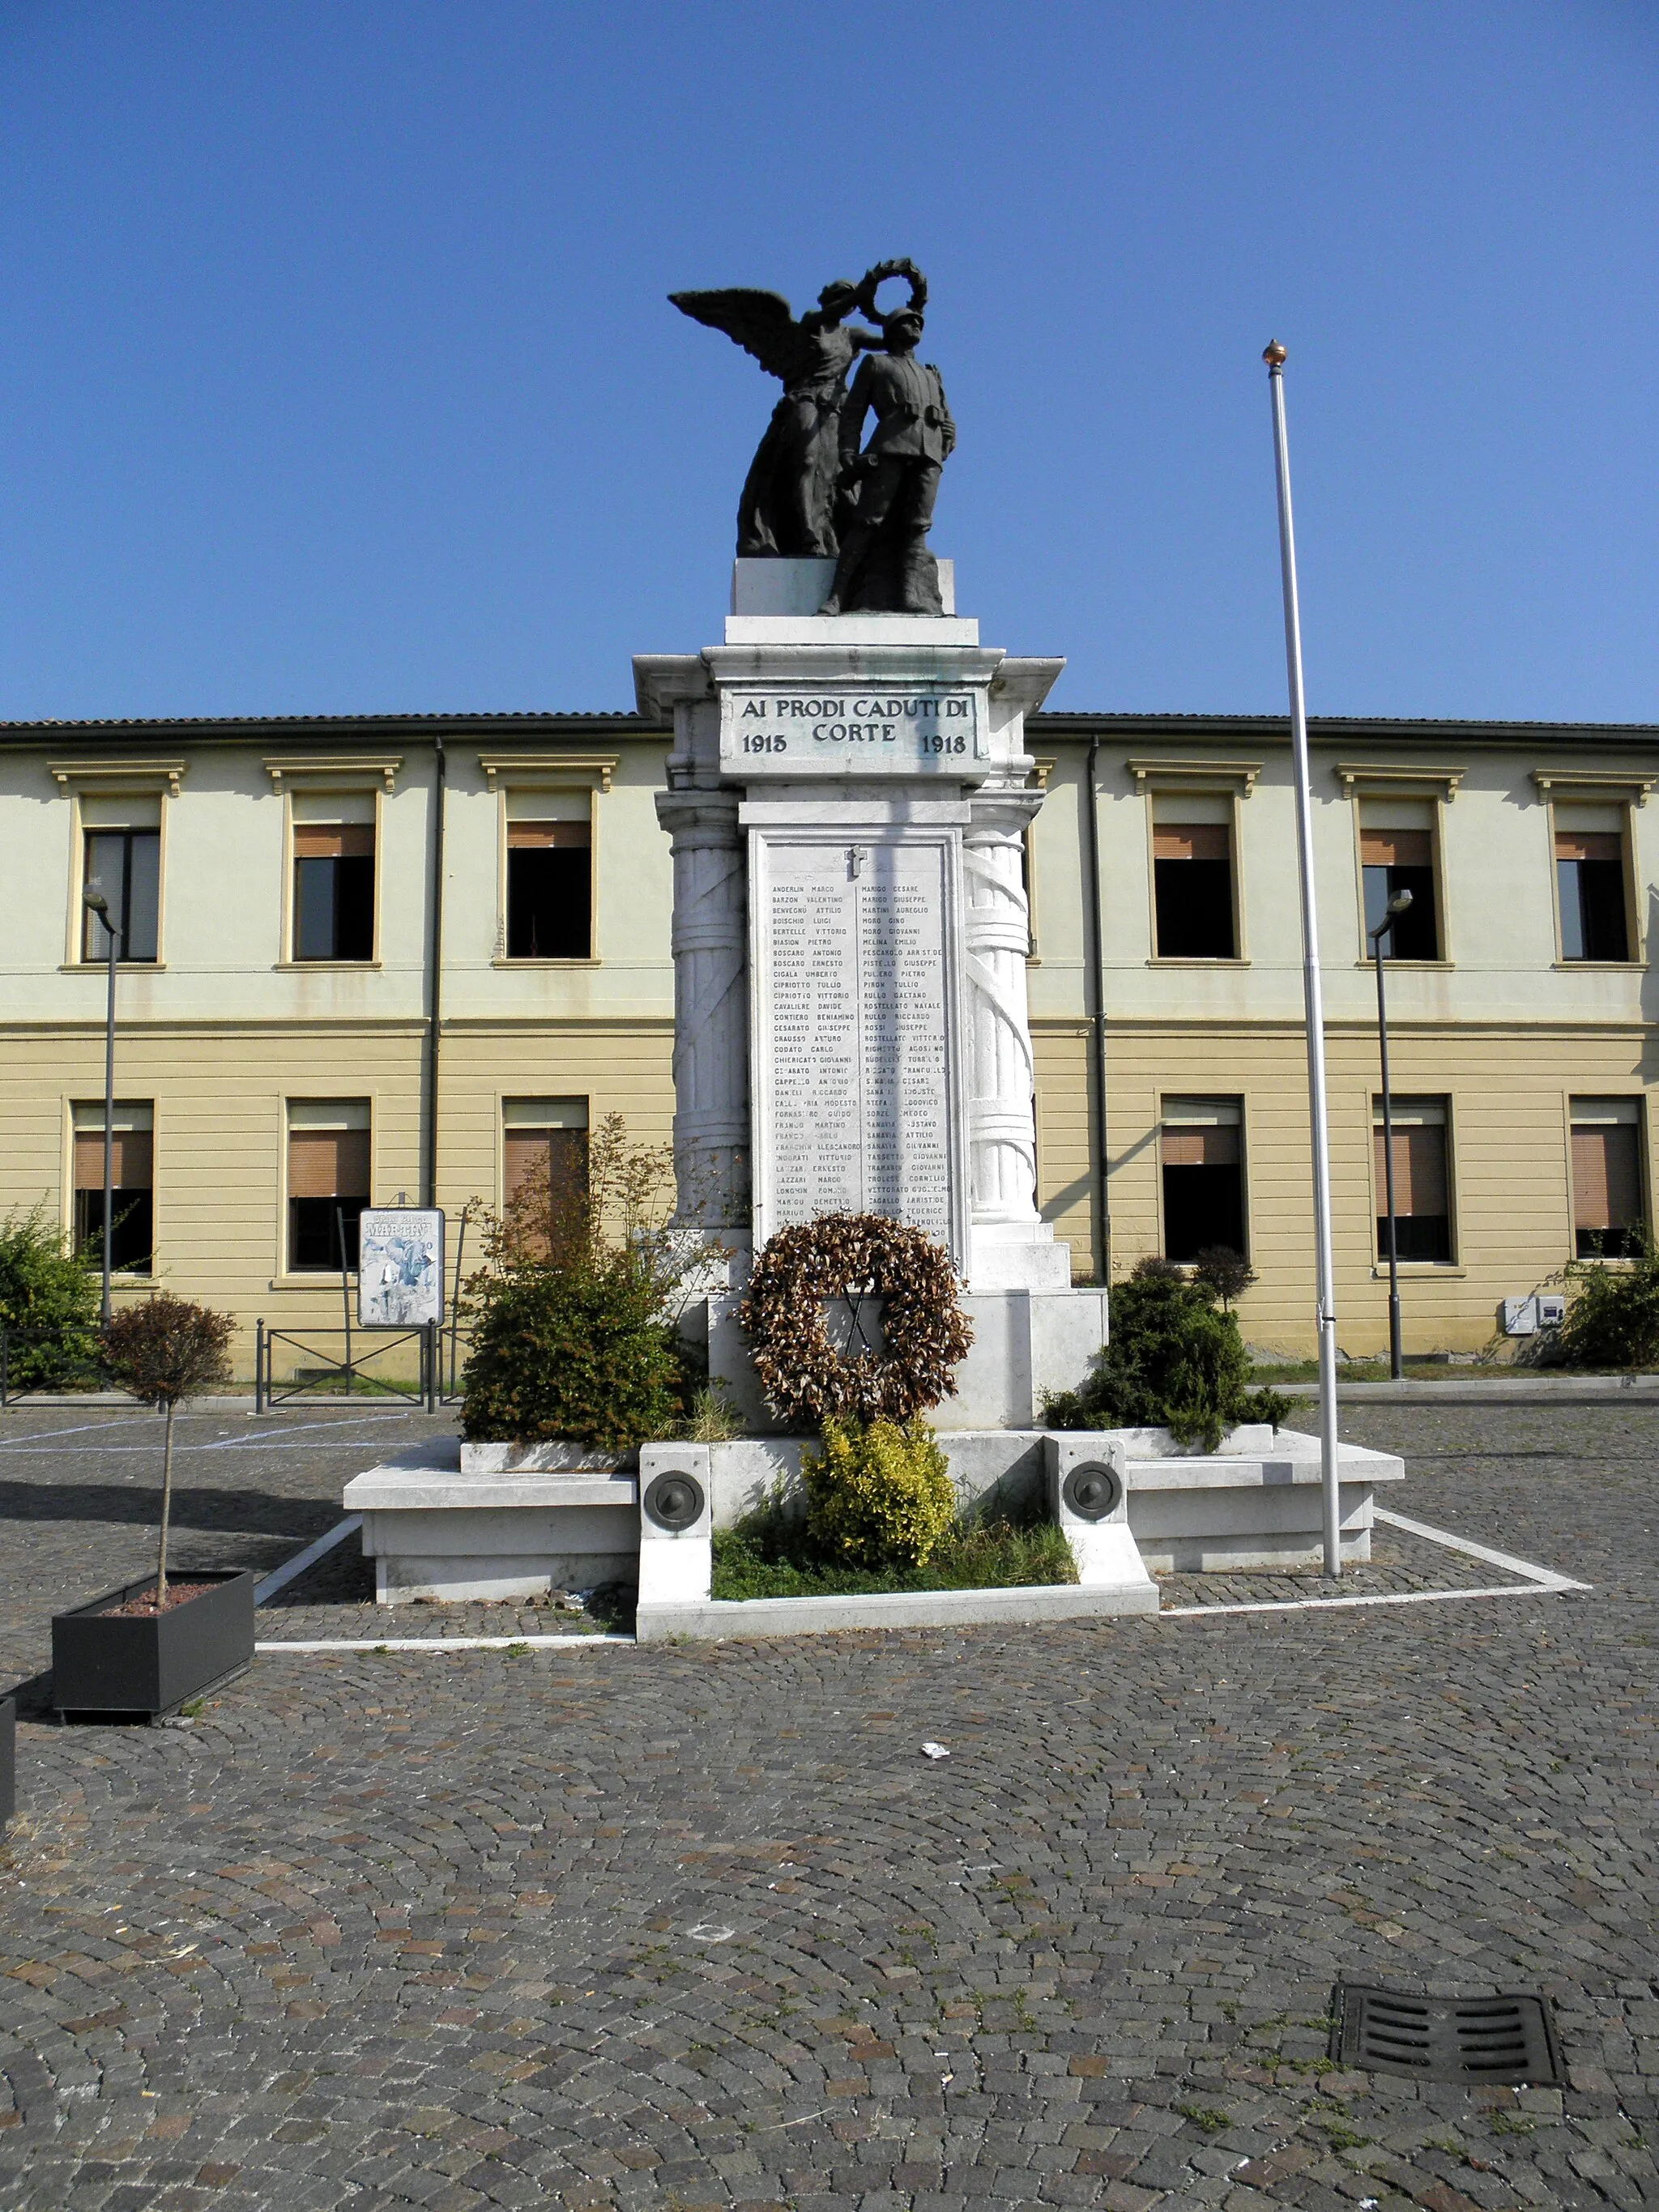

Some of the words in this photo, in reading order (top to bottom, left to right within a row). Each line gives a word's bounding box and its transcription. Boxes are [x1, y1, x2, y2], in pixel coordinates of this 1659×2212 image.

[741, 700, 766, 718] AI
[775, 700, 844, 718] PRODI
[852, 700, 940, 718] CADUTI
[945, 700, 969, 718] DI
[812, 724, 897, 742] CORTE
[741, 735, 787, 753] 1915
[922, 735, 966, 754] 1918
